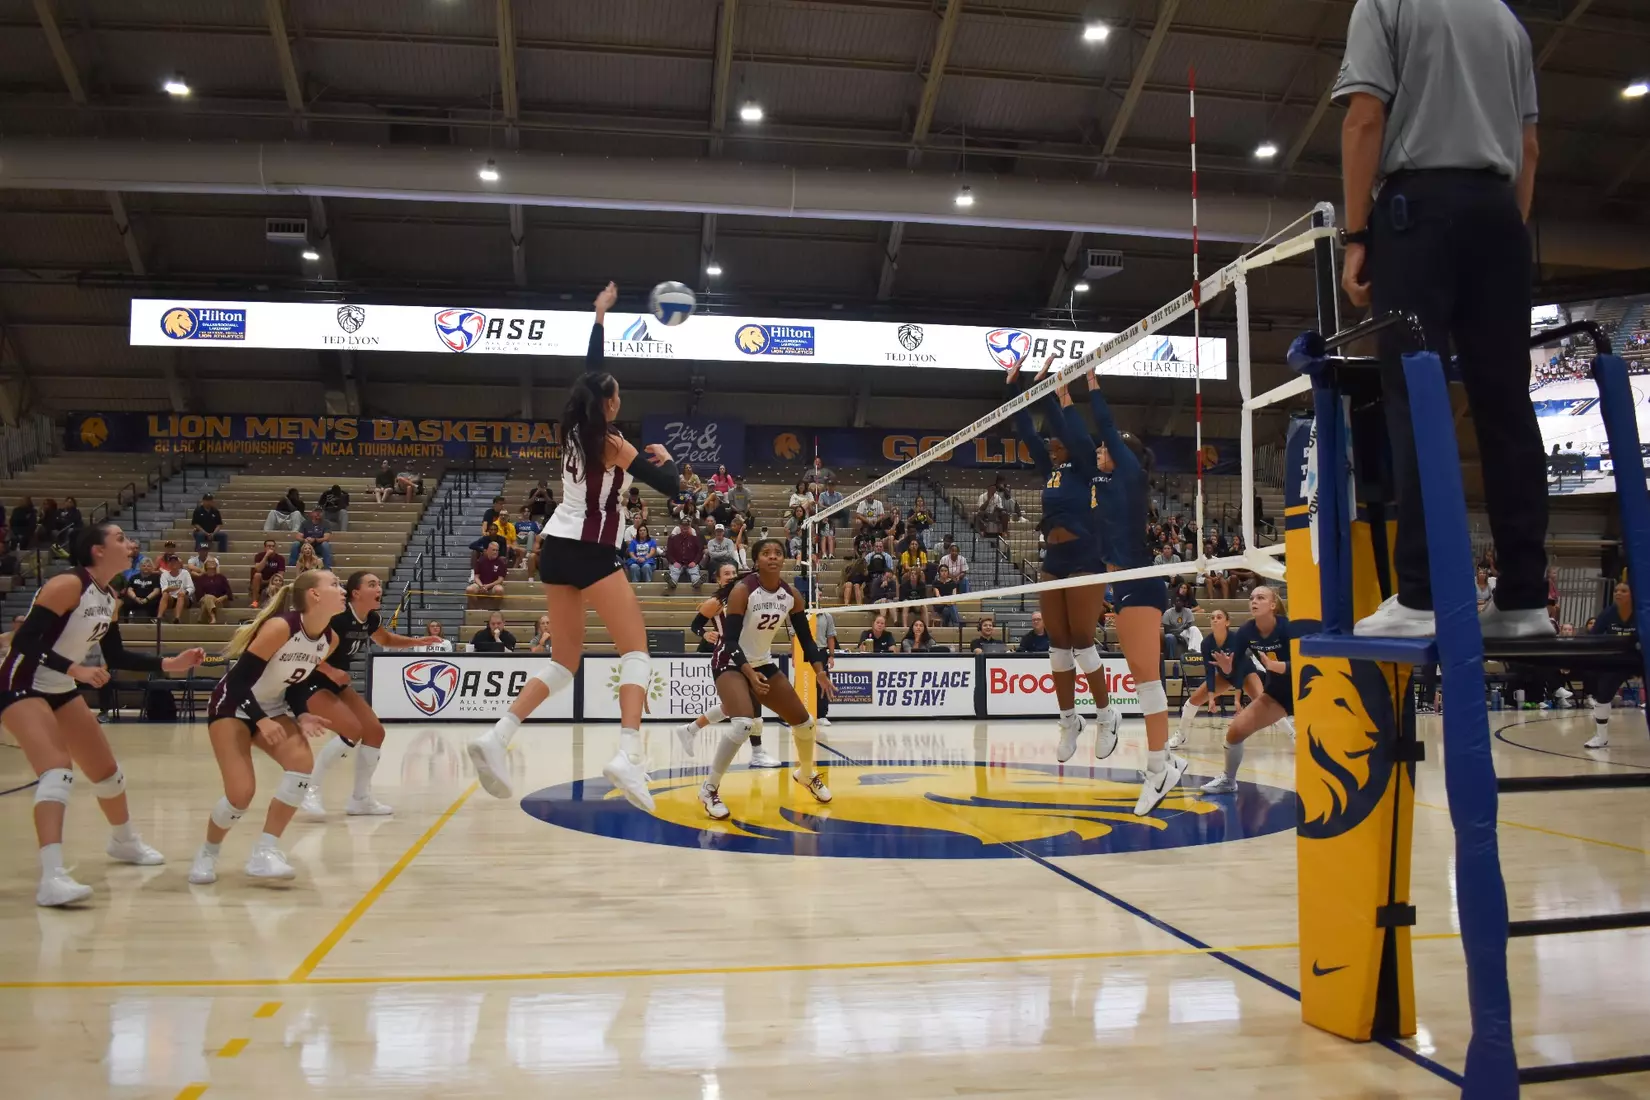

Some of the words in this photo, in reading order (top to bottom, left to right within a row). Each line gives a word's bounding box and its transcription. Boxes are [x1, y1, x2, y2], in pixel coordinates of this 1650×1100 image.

[199, 309, 243, 321] Hilton
[486, 318, 546, 340] ASG
[771, 326, 811, 338] Hilton
[322, 335, 345, 344] TED
[348, 335, 379, 345] LYON
[1032, 338, 1085, 359] ASG
[885, 352, 905, 361] TED
[909, 353, 937, 362] LYON
[1133, 360, 1197, 372] CHARTER
[147, 415, 232, 437] LION
[244, 416, 359, 440] MEN'S
[664, 422, 698, 445] Fix
[697, 423, 718, 450] &
[199, 440, 294, 455] CHAMPIONSHIPS
[311, 441, 319, 455] 7
[321, 442, 354, 456] NCAA
[357, 442, 444, 457] TOURNAMENTS
[672, 442, 722, 465] Feed
[882, 435, 953, 462] GO
[757, 613, 780, 630] 22
[86, 622, 109, 642] 12
[279, 652, 309, 662] SOUTHERN
[284, 668, 307, 685] 9
[460, 670, 528, 697] ASG
[829, 673, 869, 684] Hilton
[876, 671, 918, 688] BEST
[921, 671, 971, 688] PLACE
[990, 667, 1137, 694] Broosire
[670, 680, 716, 702] Regio
[878, 689, 898, 706] TO
[901, 689, 946, 706] STAY!
[1109, 695, 1140, 705] harm
